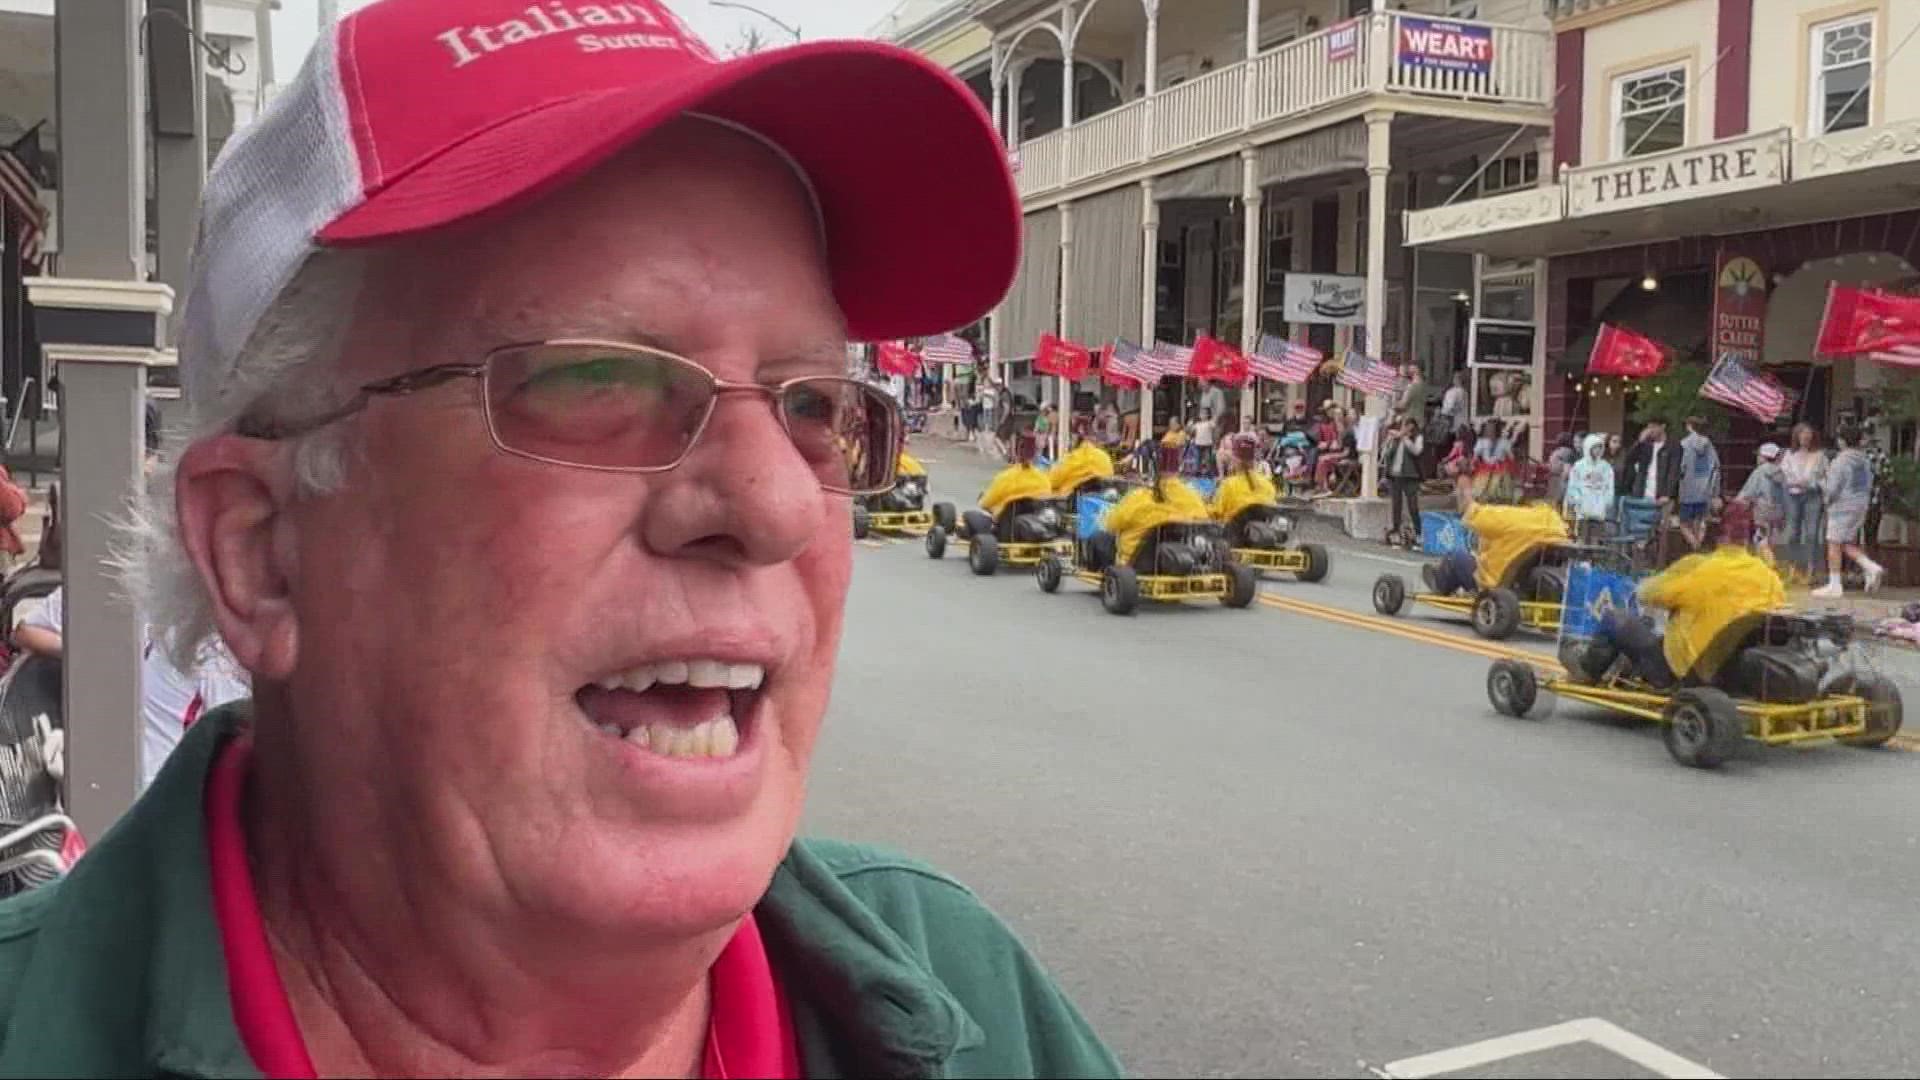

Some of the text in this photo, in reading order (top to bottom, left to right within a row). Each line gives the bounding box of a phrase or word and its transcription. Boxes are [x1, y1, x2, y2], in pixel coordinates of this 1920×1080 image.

[435, 0, 661, 67] Italian
[1403, 27, 1489, 60] WEART
[1591, 148, 1757, 202] THEATRE
